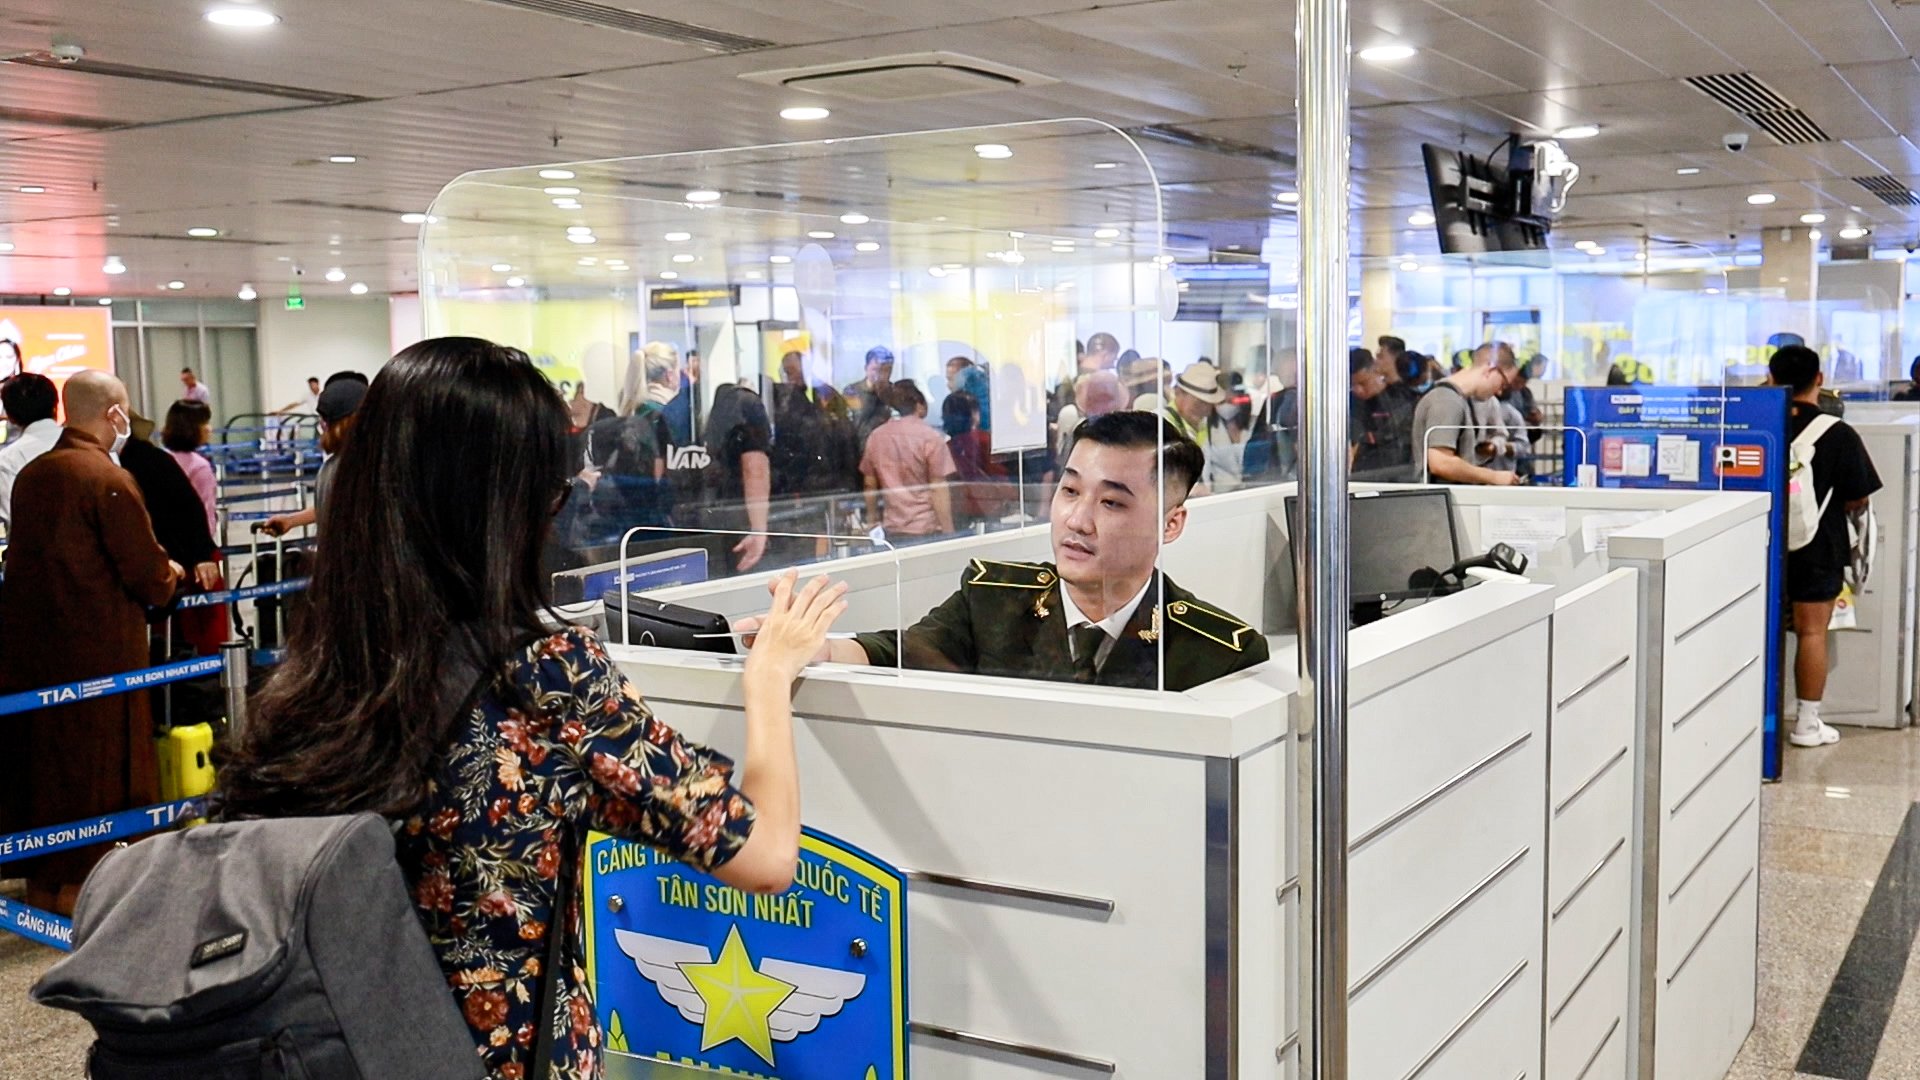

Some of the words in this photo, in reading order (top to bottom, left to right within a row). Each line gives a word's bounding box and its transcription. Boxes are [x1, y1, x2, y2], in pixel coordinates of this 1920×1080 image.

[181, 594, 208, 607] TIA
[125, 675, 144, 686] TAN
[145, 671, 164, 682] SON
[166, 666, 190, 678] NHAT
[38, 687, 76, 705] TIA
[16, 836, 44, 852] TÂN
[47, 830, 76, 847] SƠN
[78, 818, 113, 840] NHẤT
[597, 840, 646, 875] CẢNG
[794, 858, 850, 905] QUỐC
[858, 883, 884, 923] TẾ
[657, 875, 699, 908] TÂN
[704, 884, 749, 918] SƠN
[754, 889, 815, 929] NHẤT
[17, 908, 44, 933] CẢNG
